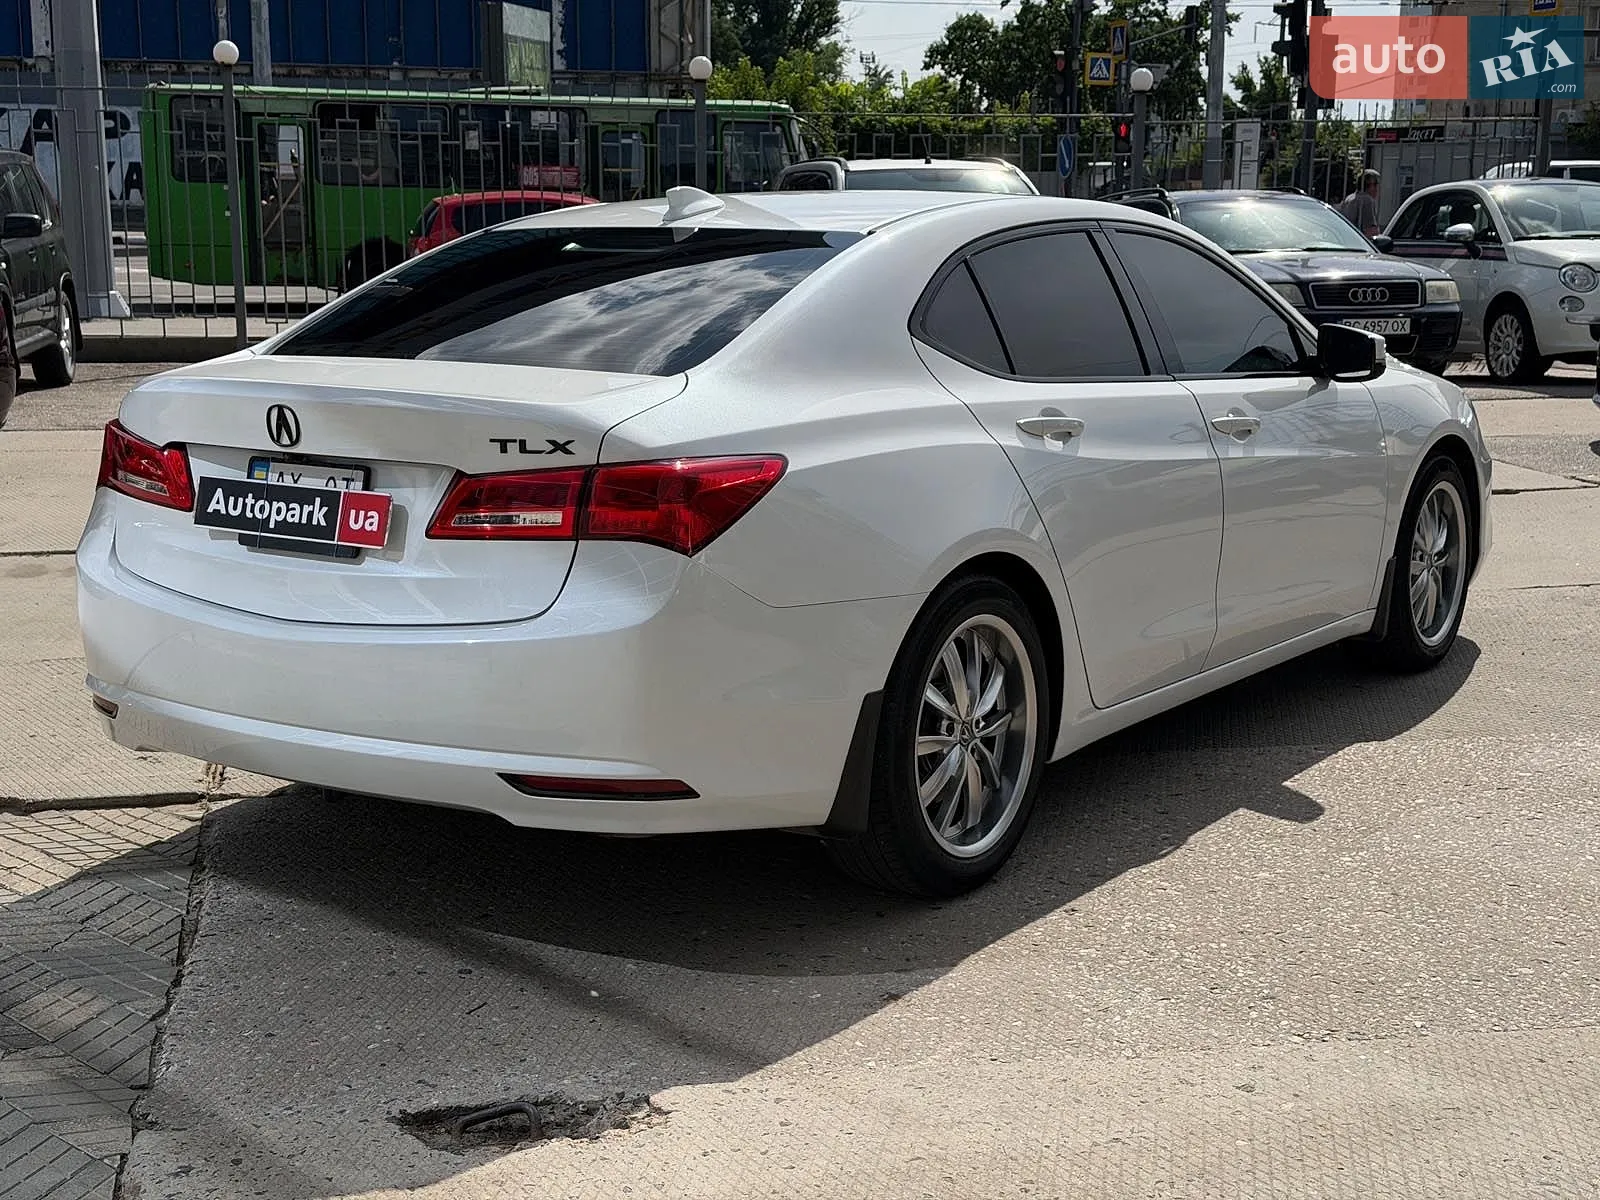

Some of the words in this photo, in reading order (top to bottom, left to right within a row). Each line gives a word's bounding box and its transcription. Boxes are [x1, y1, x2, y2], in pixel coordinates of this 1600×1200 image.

[489, 438, 576, 455] TLX
[206, 487, 329, 528] Autopark
[349, 509, 379, 532] ua
